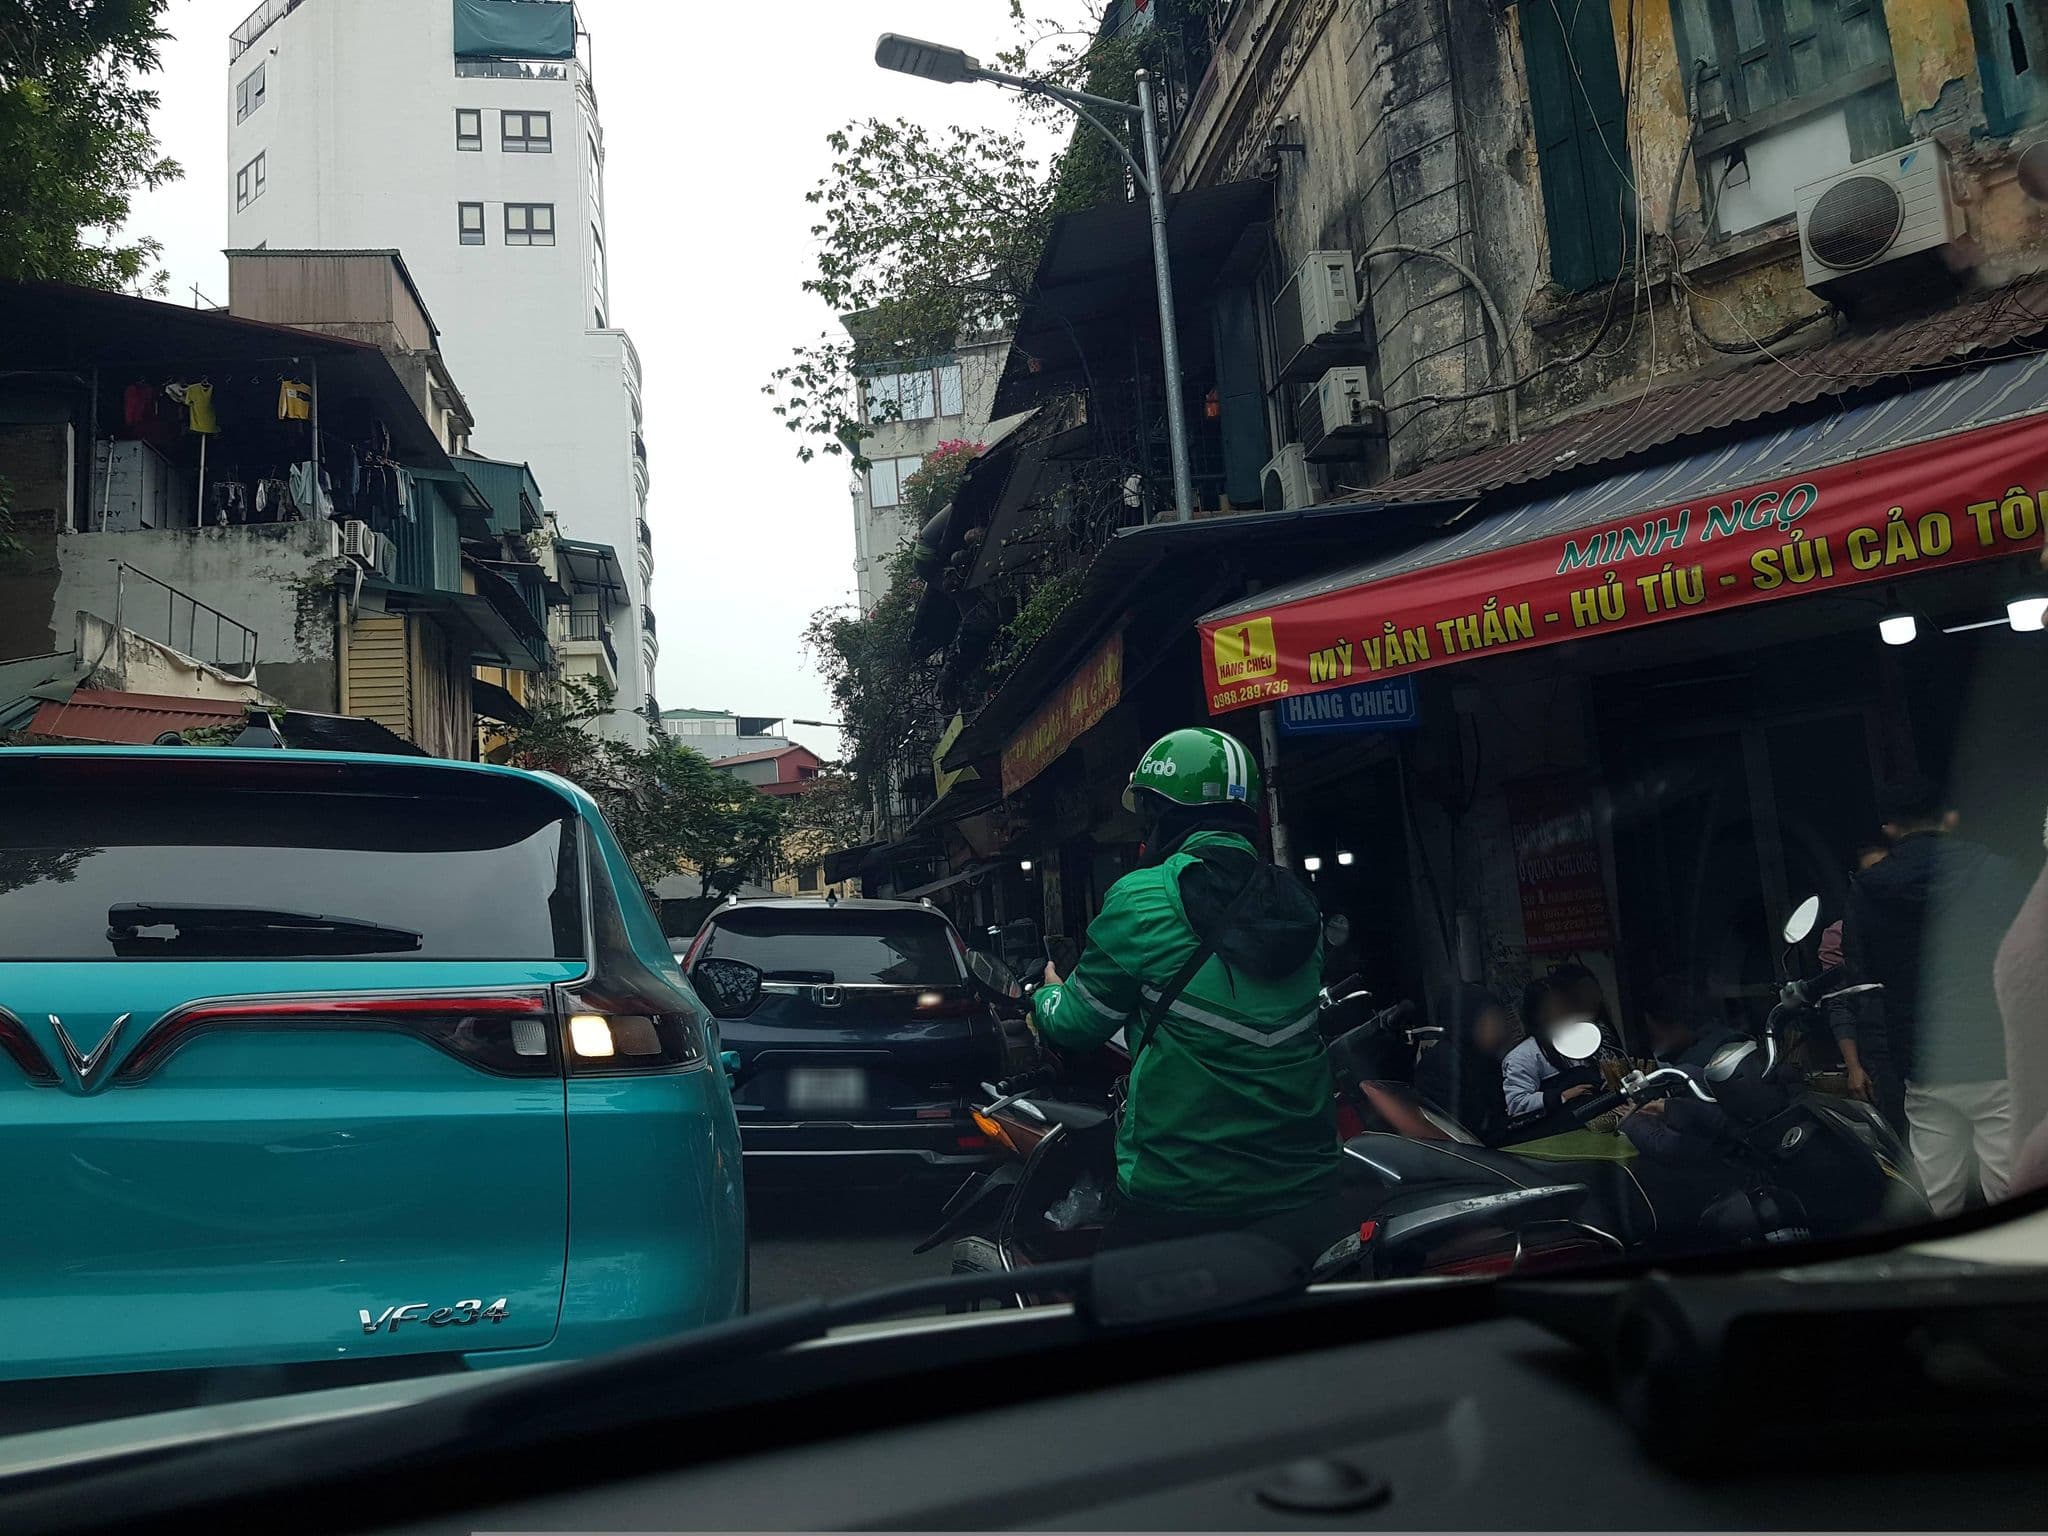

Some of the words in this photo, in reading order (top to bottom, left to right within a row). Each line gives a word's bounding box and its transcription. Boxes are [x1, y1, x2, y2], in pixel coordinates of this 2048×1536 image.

[1556, 509, 1691, 574] MINH
[1700, 483, 1818, 541] NGỌ
[1308, 638, 1353, 684] MỲ
[1361, 620, 1431, 672] VẰN
[1436, 596, 1534, 655] THẮN
[1570, 571, 1626, 628] HỦ
[1636, 563, 1707, 613] TÍU
[1750, 529, 1834, 590] SỦI
[1847, 506, 1952, 571] CẢO
[1237, 627, 1251, 657] 1
[1219, 661, 1244, 679] HÀNG
[1213, 679, 1288, 708] 0988.289.736
[1141, 756, 1177, 777] Grab
